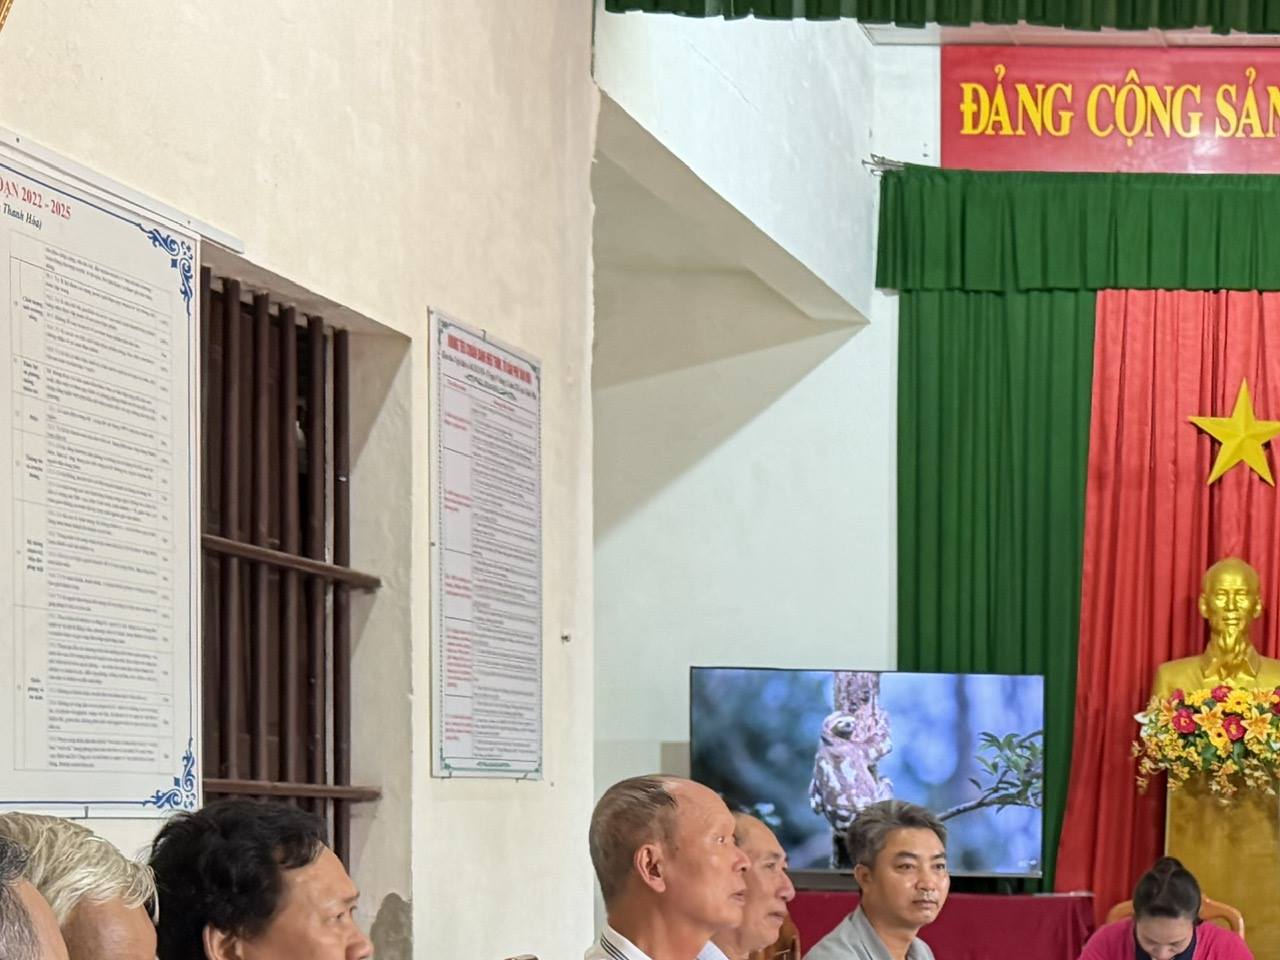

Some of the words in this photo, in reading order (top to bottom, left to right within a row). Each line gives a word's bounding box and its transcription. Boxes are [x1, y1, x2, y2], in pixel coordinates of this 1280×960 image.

[960, 64, 1073, 136] ĐẢNG
[1087, 69, 1202, 146] CỘNG
[22, 186, 42, 209] 2022
[50, 199, 71, 220] 2025
